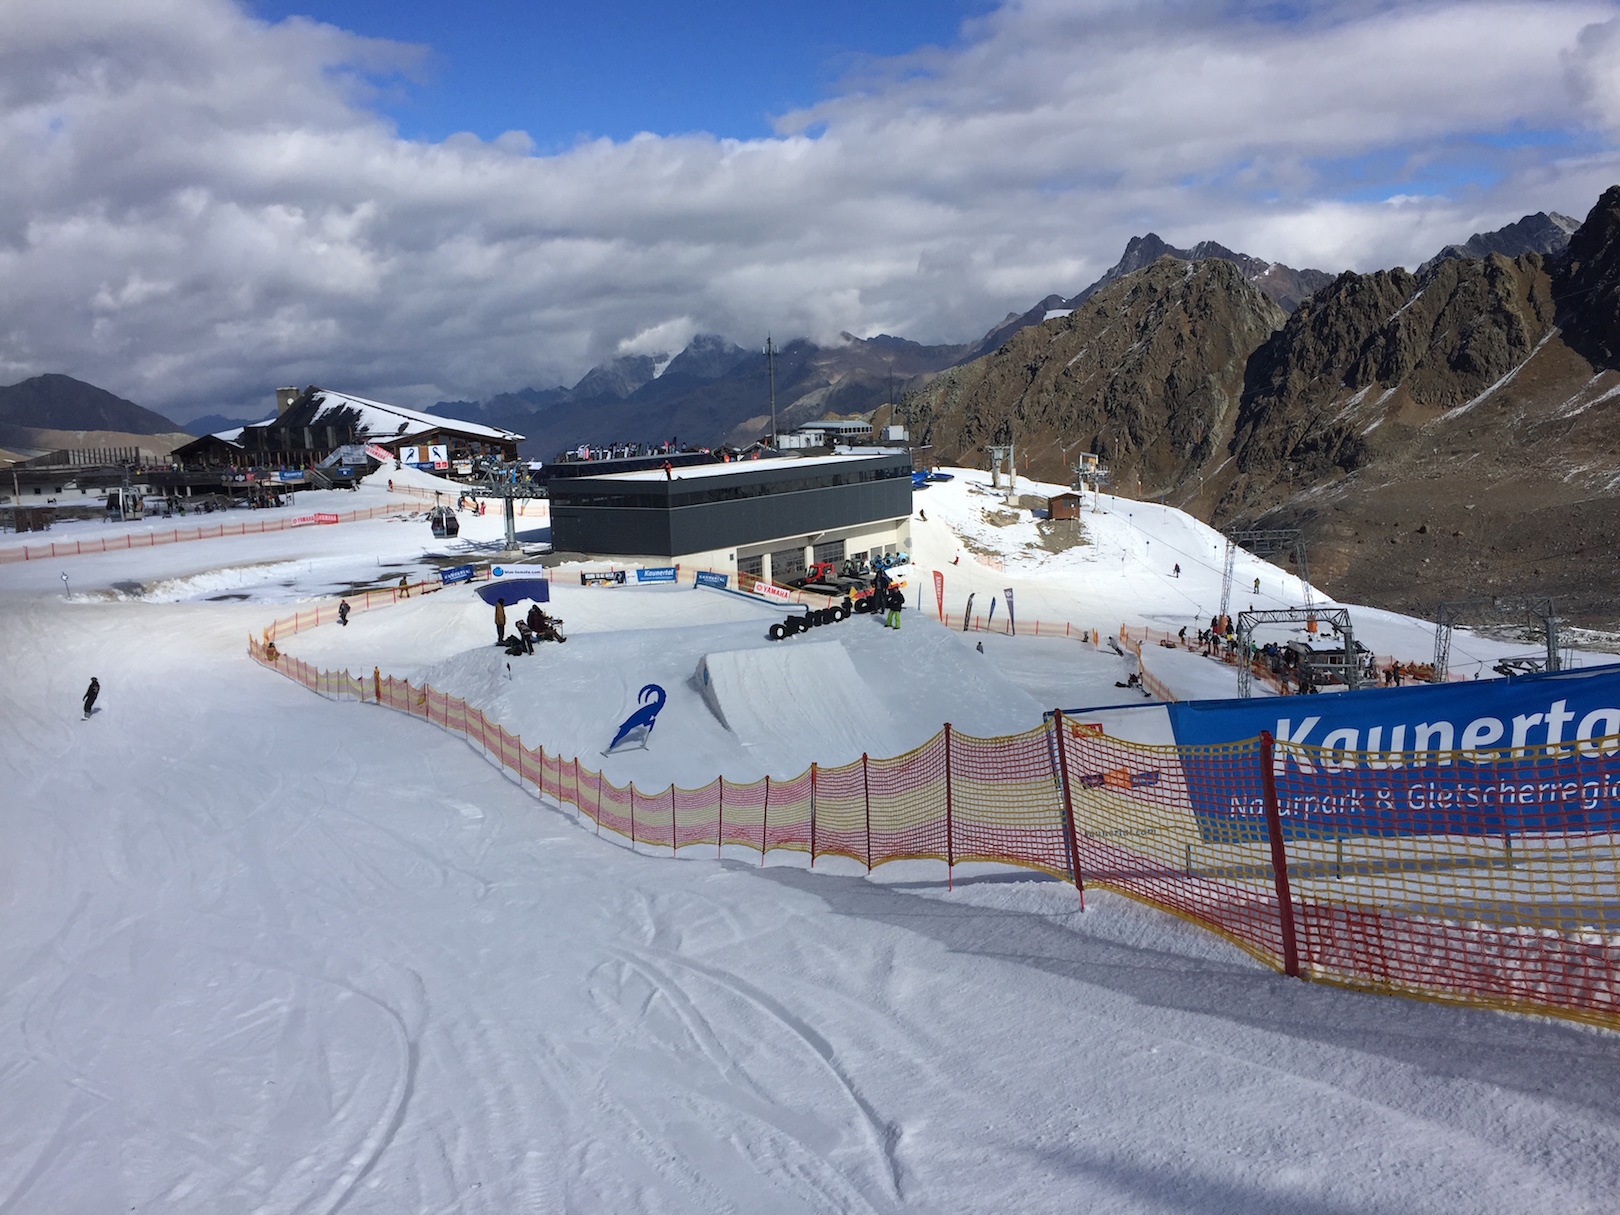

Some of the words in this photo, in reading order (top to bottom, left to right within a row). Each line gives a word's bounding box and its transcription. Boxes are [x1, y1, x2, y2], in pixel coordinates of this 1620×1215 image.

[763, 585, 789, 599] YAMAHA
[1230, 788, 1365, 820] Naurpark
[1376, 786, 1397, 810] &
